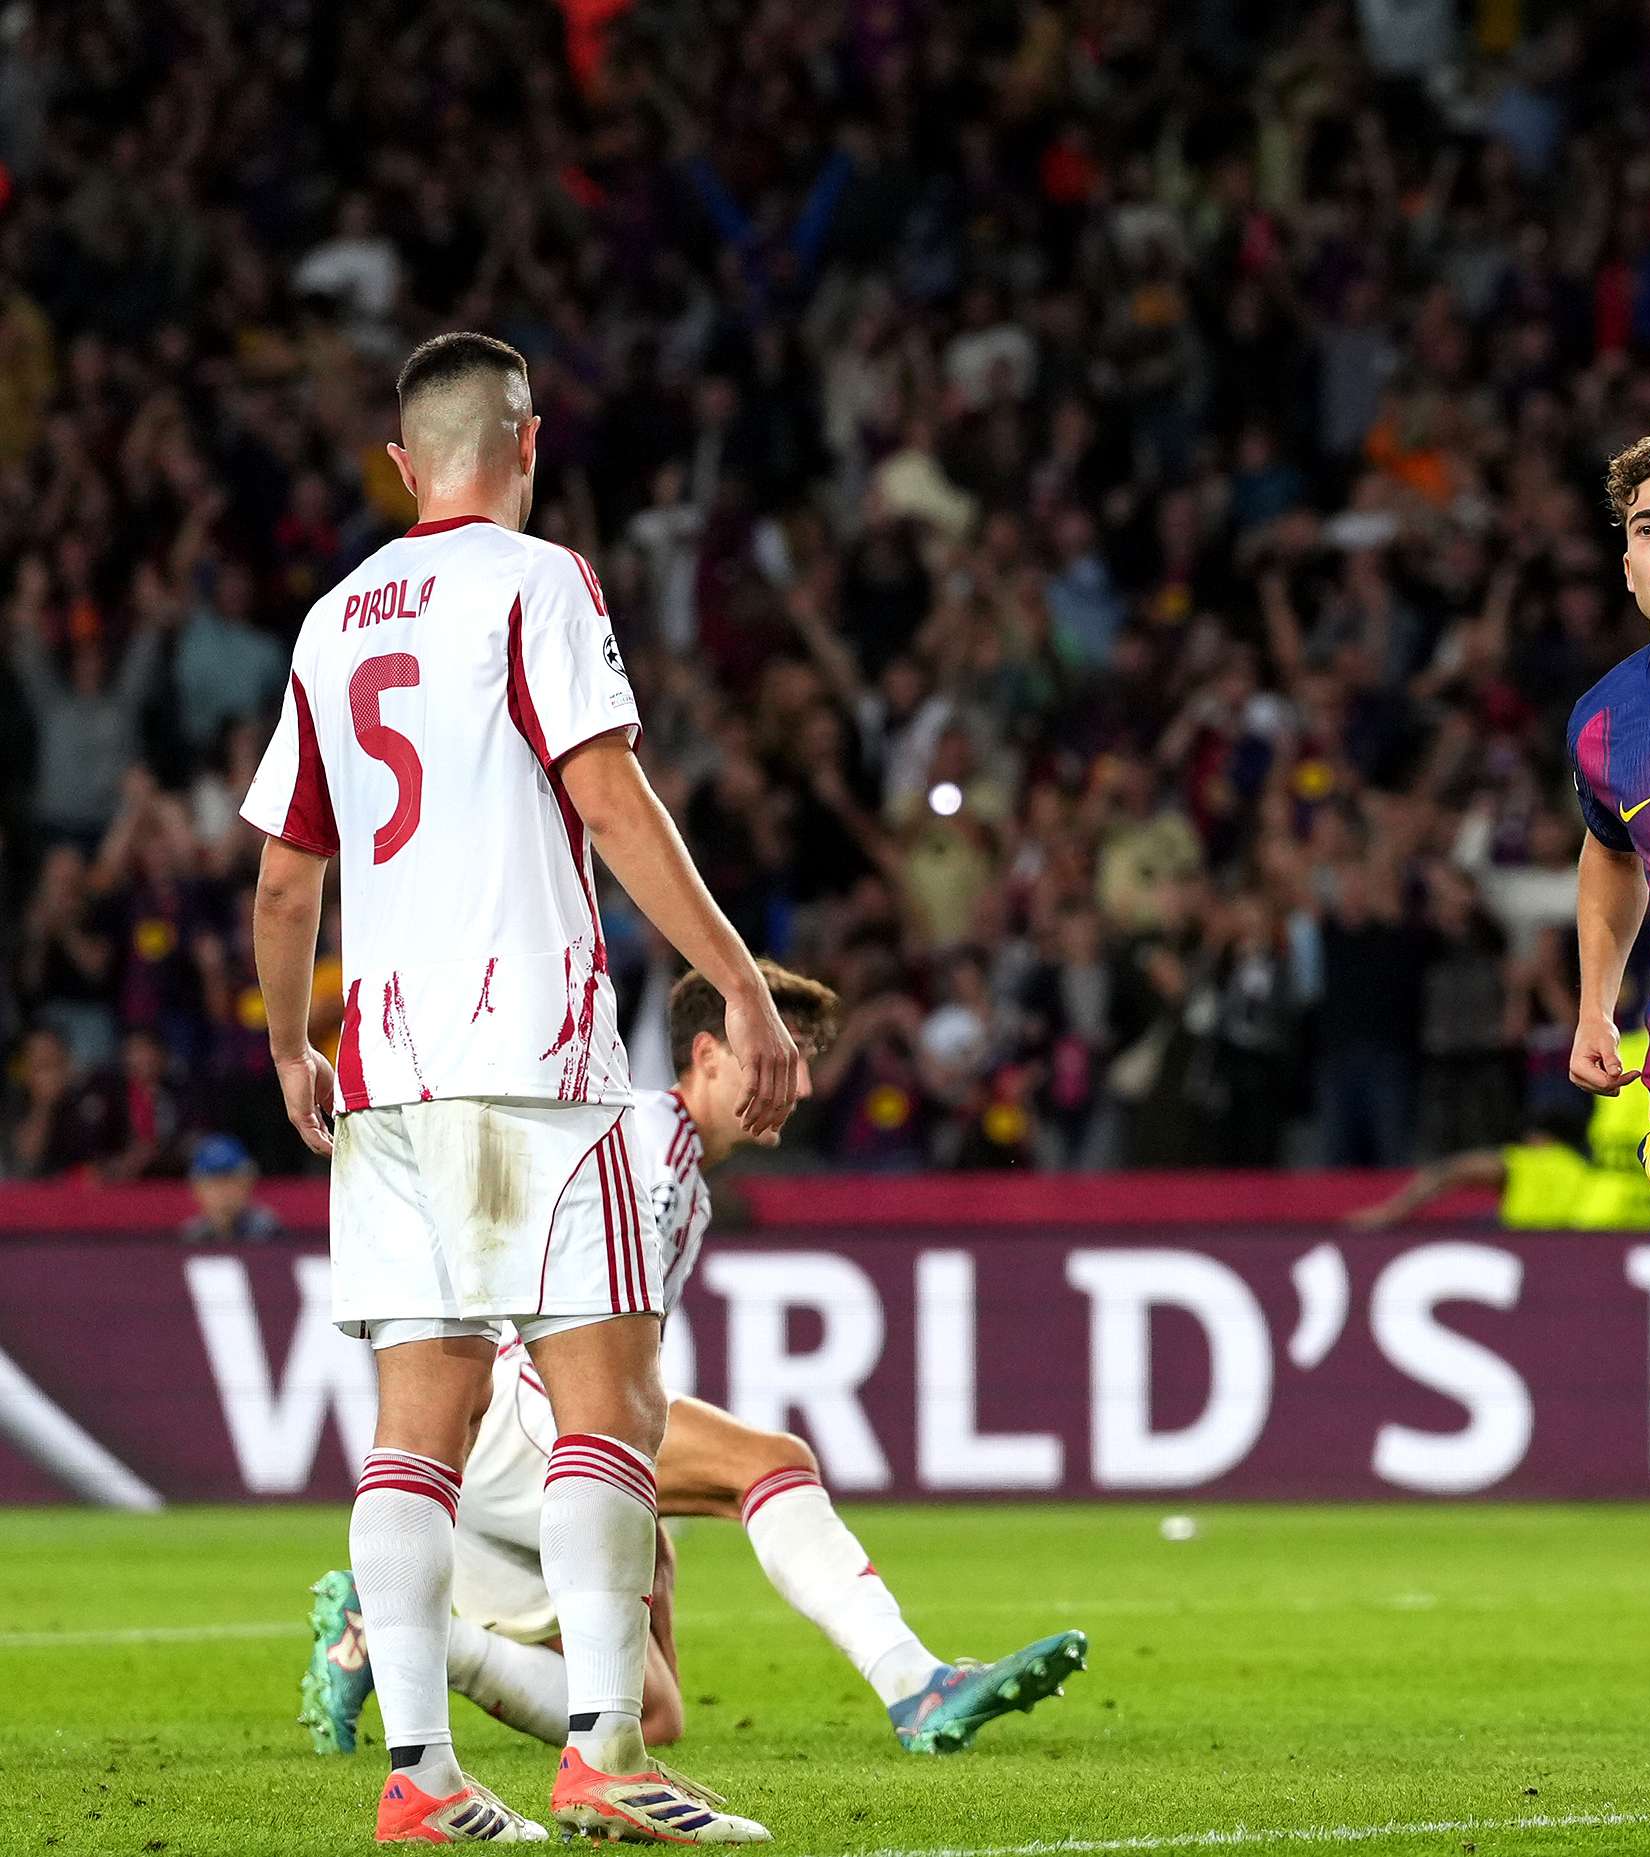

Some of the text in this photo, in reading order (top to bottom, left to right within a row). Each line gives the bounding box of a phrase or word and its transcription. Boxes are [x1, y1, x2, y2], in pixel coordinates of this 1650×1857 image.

[342, 576, 436, 632] PIROLA
[348, 652, 423, 865] 5
[183, 1242, 1534, 1494] WRLD'S
